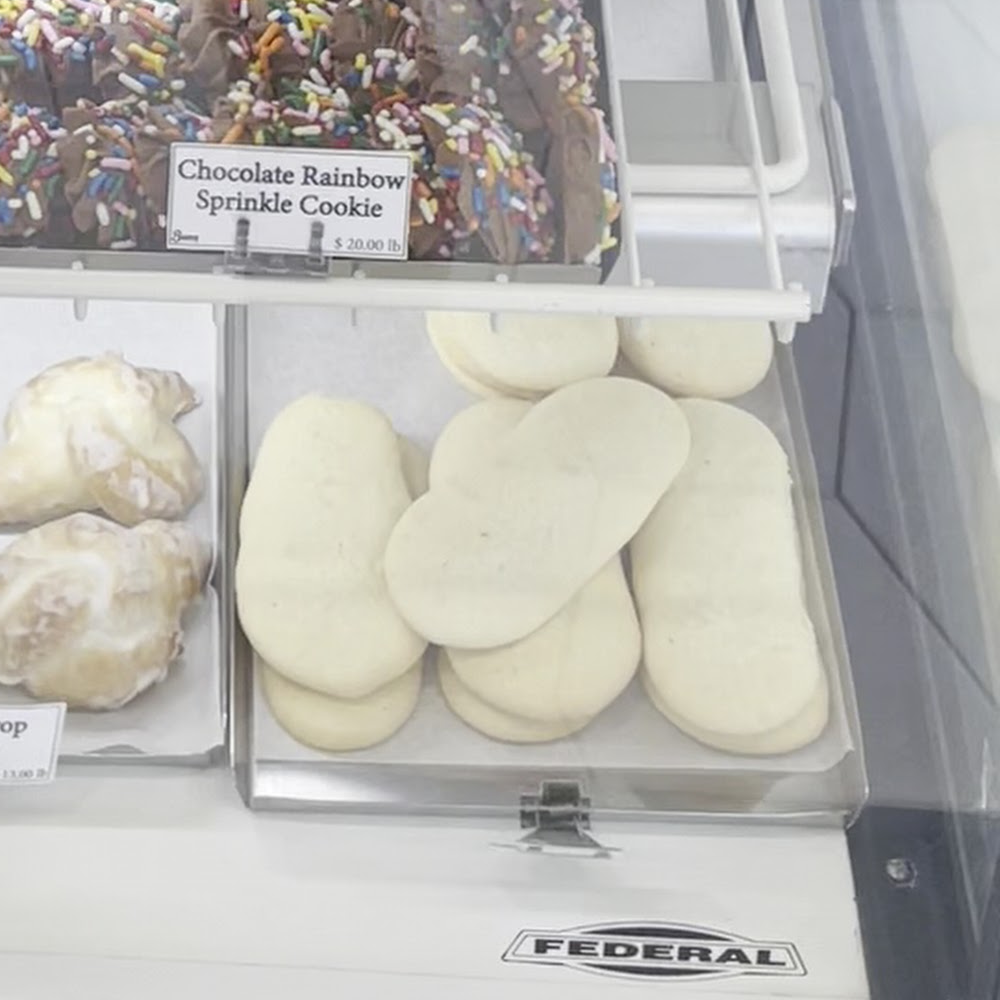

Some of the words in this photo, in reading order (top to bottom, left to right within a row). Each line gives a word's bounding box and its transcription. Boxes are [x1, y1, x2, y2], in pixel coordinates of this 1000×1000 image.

[178, 159, 295, 185] Chocolate
[300, 166, 406, 190] Rainbow
[195, 189, 293, 216] Sprinkle
[299, 195, 383, 218] Cookie
[334, 239, 343, 251] $
[349, 239, 384, 251] 20.00
[387, 240, 401, 252] lb
[534, 938, 786, 966] FEDERAL
